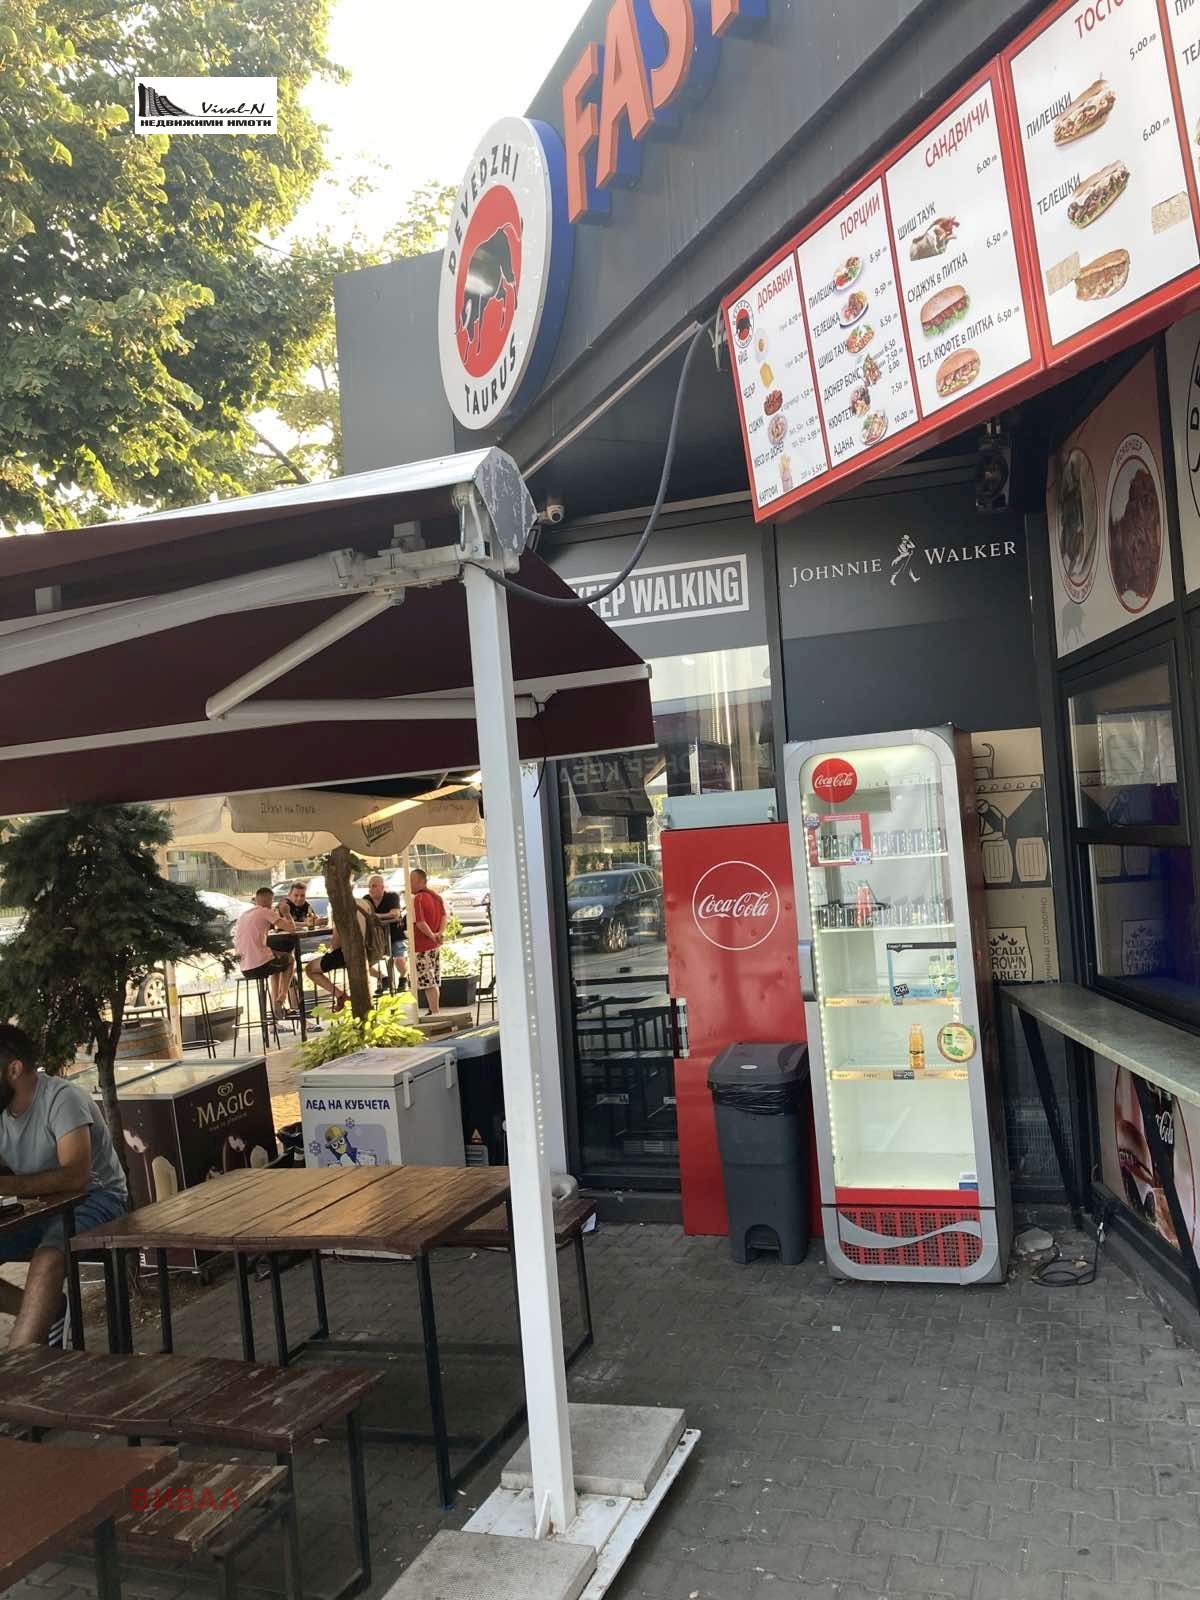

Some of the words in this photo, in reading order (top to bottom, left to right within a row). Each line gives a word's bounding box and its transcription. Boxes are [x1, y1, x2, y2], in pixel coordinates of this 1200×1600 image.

[1074, 0, 1124, 38] ТОСТ
[1129, 37, 1148, 61] 5.00
[562, 0, 738, 224] FAS
[1026, 92, 1072, 139] ПИЛЕШКИ
[1142, 120, 1161, 141] 6.00
[925, 98, 990, 168] САНДВИЧИ
[976, 157, 991, 175] 6.00
[448, 143, 520, 275] DEVEDZHI
[1037, 172, 1081, 215] ТЕЛЕШКИ
[840, 193, 881, 240] ПОРЦИИ
[897, 217, 918, 240] ШИШ
[917, 202, 936, 224] ТАУК
[757, 266, 795, 314] ДОБАВКИ
[808, 279, 838, 309] ПИЛЕШКА
[907, 273, 936, 303] СУДЖУК
[941, 252, 968, 281] ПИТКА
[812, 312, 840, 338] ТЕЛЕШКА
[918, 351, 934, 369] ТЕЛ.
[934, 334, 961, 359] КЮФТЕ
[966, 315, 994, 338] ПИТКА
[463, 332, 517, 416] TAURUS
[817, 349, 834, 369] ШИШ
[833, 436, 854, 456] АДАНА
[629, 566, 740, 615] WALKING
[698, 892, 772, 918] Coca-Cola
[989, 946, 1025, 956] OCALLY
[991, 956, 1026, 970] ROWN
[992, 970, 1027, 980] ARLEY
[305, 1099, 326, 1111] ЛЕД
[328, 1099, 343, 1110] НА
[344, 1099, 391, 1110] КУБЧЕТА
